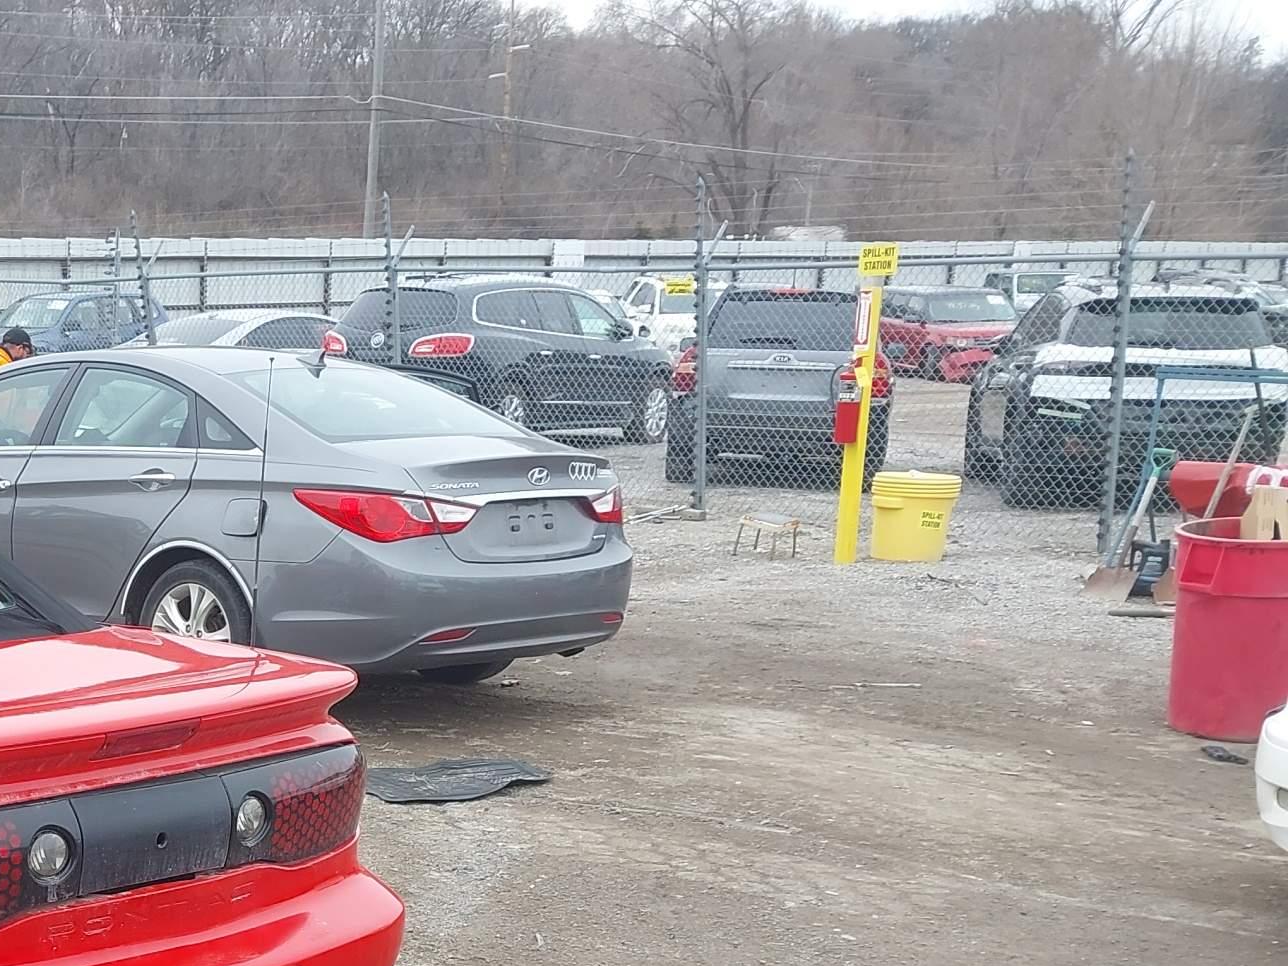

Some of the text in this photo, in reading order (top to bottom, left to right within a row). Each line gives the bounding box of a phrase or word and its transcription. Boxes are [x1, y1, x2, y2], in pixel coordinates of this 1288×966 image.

[862, 247, 897, 258] SPILL-KIT
[863, 260, 892, 271] STATION
[428, 482, 481, 490] SONATA
